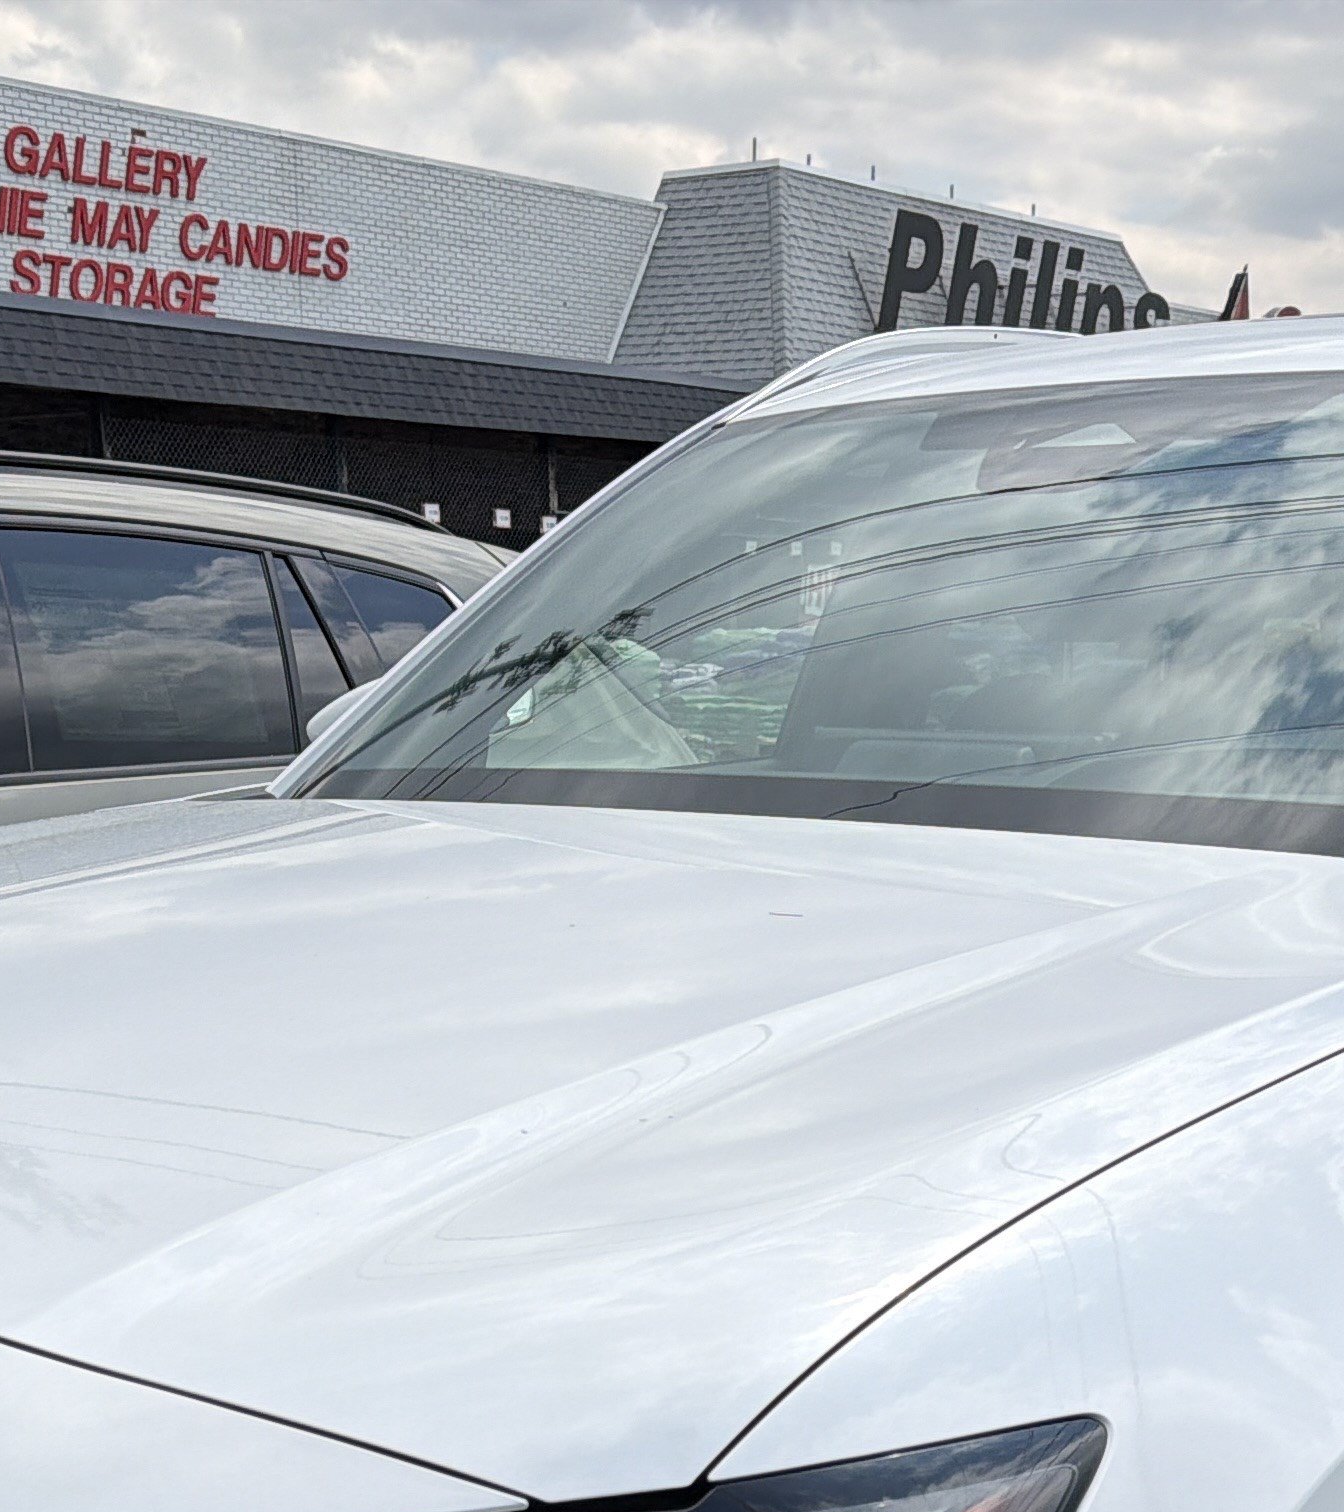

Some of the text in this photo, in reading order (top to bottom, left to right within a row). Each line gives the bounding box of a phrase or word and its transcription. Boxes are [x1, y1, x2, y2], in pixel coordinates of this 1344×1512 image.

[4, 125, 207, 201] GALLERY
[71, 197, 160, 253] MAY
[179, 213, 350, 282] CANDIES
[10, 250, 221, 318] STORAGE
